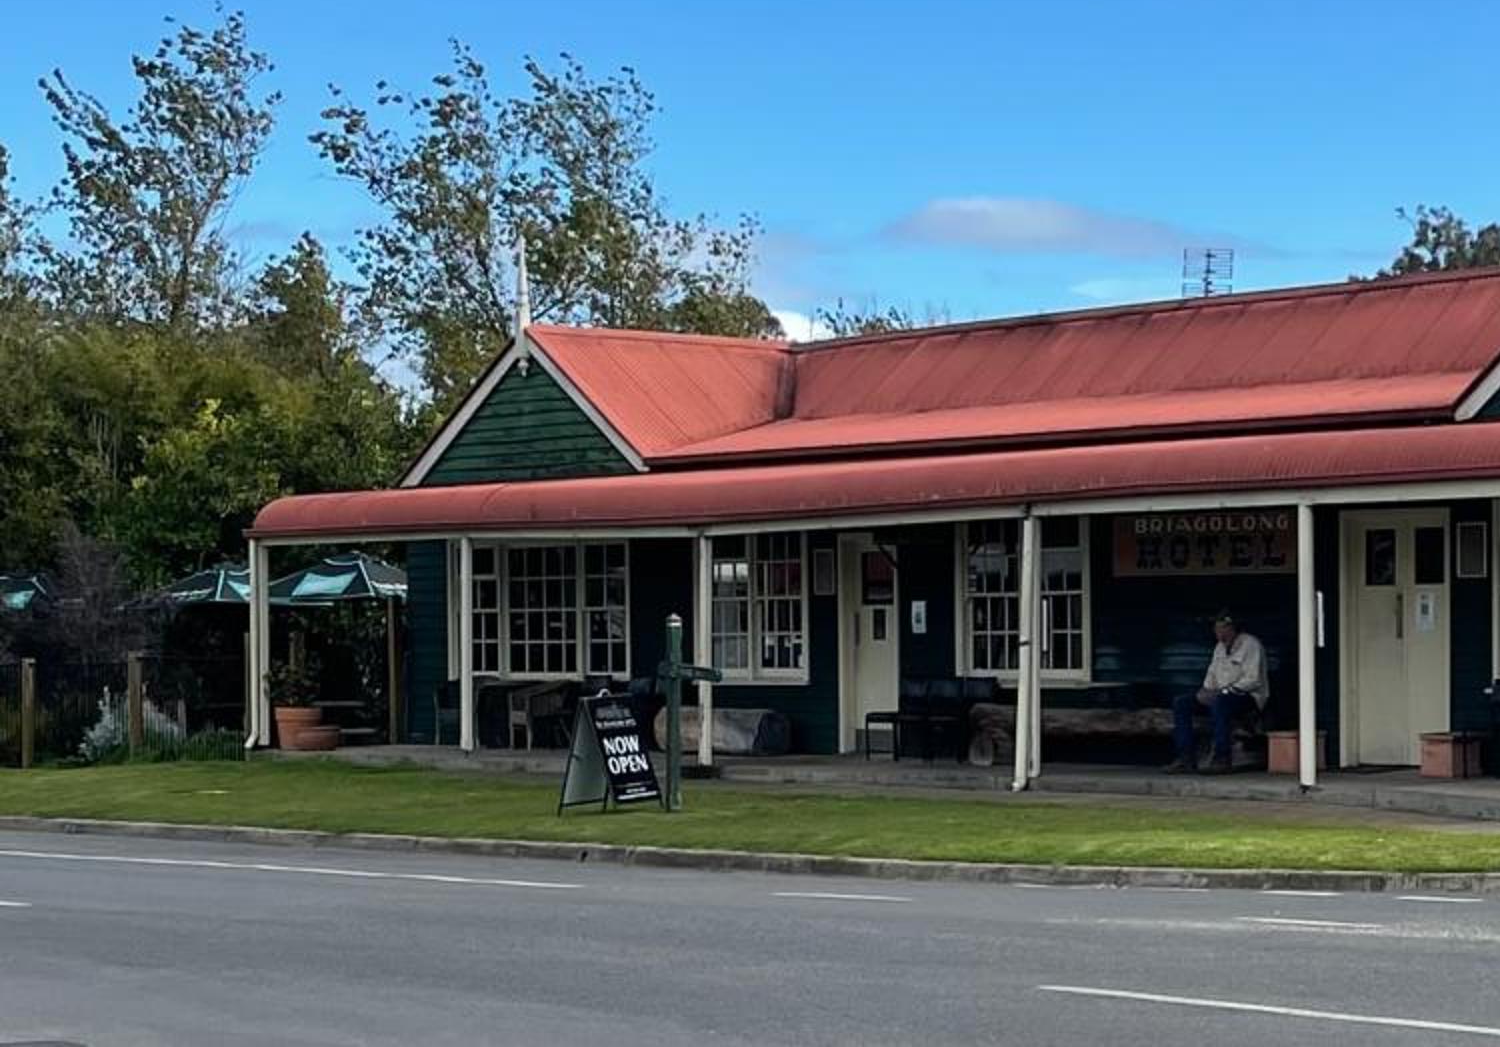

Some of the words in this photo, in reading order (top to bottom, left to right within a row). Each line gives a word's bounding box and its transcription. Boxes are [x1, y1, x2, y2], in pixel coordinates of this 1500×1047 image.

[1135, 514, 1289, 534] BRIAGOLONG
[1136, 534, 1286, 569] HOTEL
[603, 735, 639, 755] NOW
[607, 755, 649, 775] OPEN
